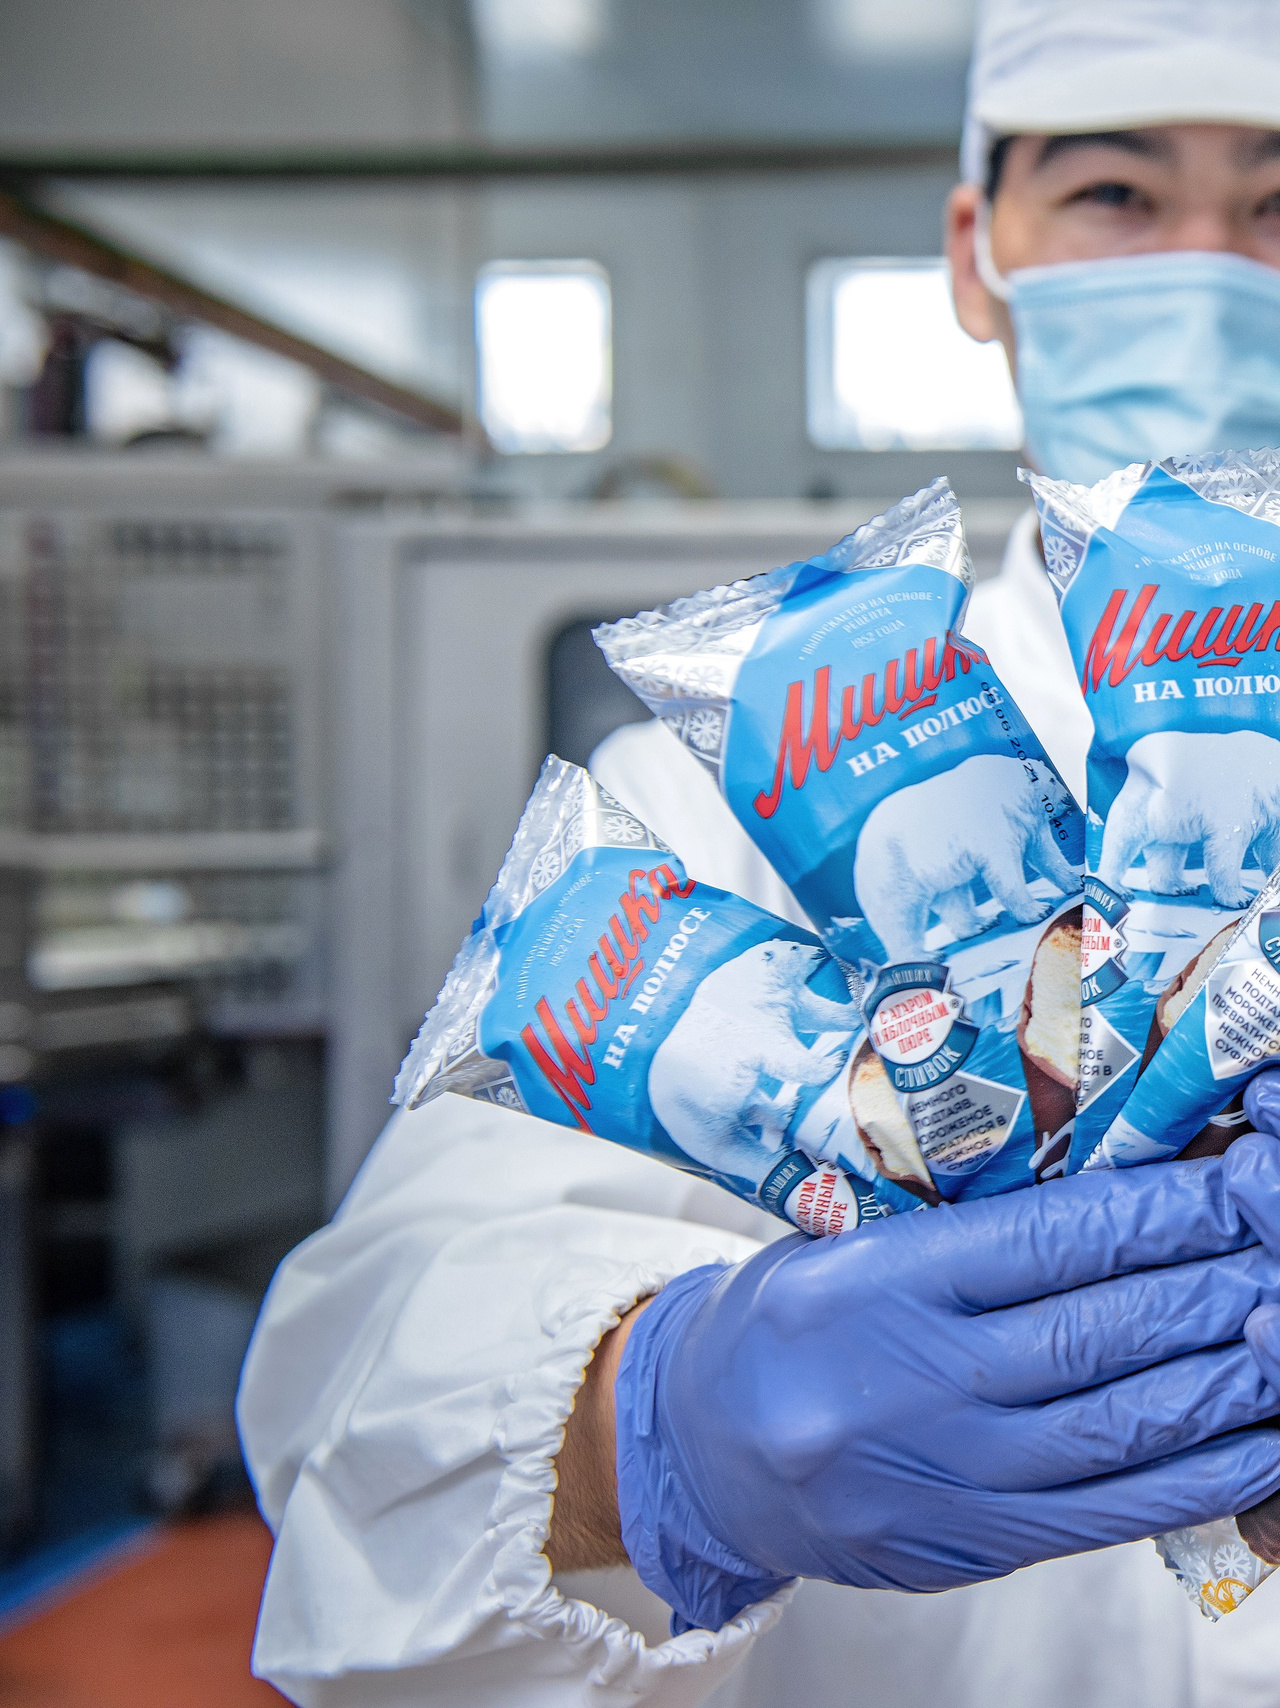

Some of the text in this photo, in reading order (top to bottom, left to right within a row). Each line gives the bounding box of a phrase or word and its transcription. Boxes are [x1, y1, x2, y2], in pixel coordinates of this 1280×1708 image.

[1214, 541, 1231, 551] НА
[1233, 542, 1278, 563] ОСНОВЕ
[801, 591, 934, 655] ВЫПУСКАЕТСЯ НА ОСНОВЕ
[842, 607, 893, 633] РЕЦЕПТА
[874, 619, 906, 638] ГОДА
[1133, 680, 1185, 703] НА
[846, 686, 1005, 777] НА ПОЛЮСЕ
[1041, 794, 1069, 841] 10:46
[520, 863, 697, 1135] Мишка
[601, 906, 712, 1070] НА ПОЛЮСЕ
[1081, 975, 1103, 1001] ОК
[879, 990, 934, 1025] С АГАРОМ
[880, 1002, 949, 1044] ЯБЛОЧНЫМ
[897, 1027, 933, 1054] ПЮРЕ
[894, 1043, 963, 1089] СЛИВОК
[1103, 1065, 1112, 1076] В
[909, 1084, 967, 1116] НЕМНОГО
[918, 1105, 993, 1145] ОРОЖЕНОЕ
[923, 1115, 1007, 1159] ЕВРАТИТСЯ В
[858, 1192, 880, 1224] ОК
